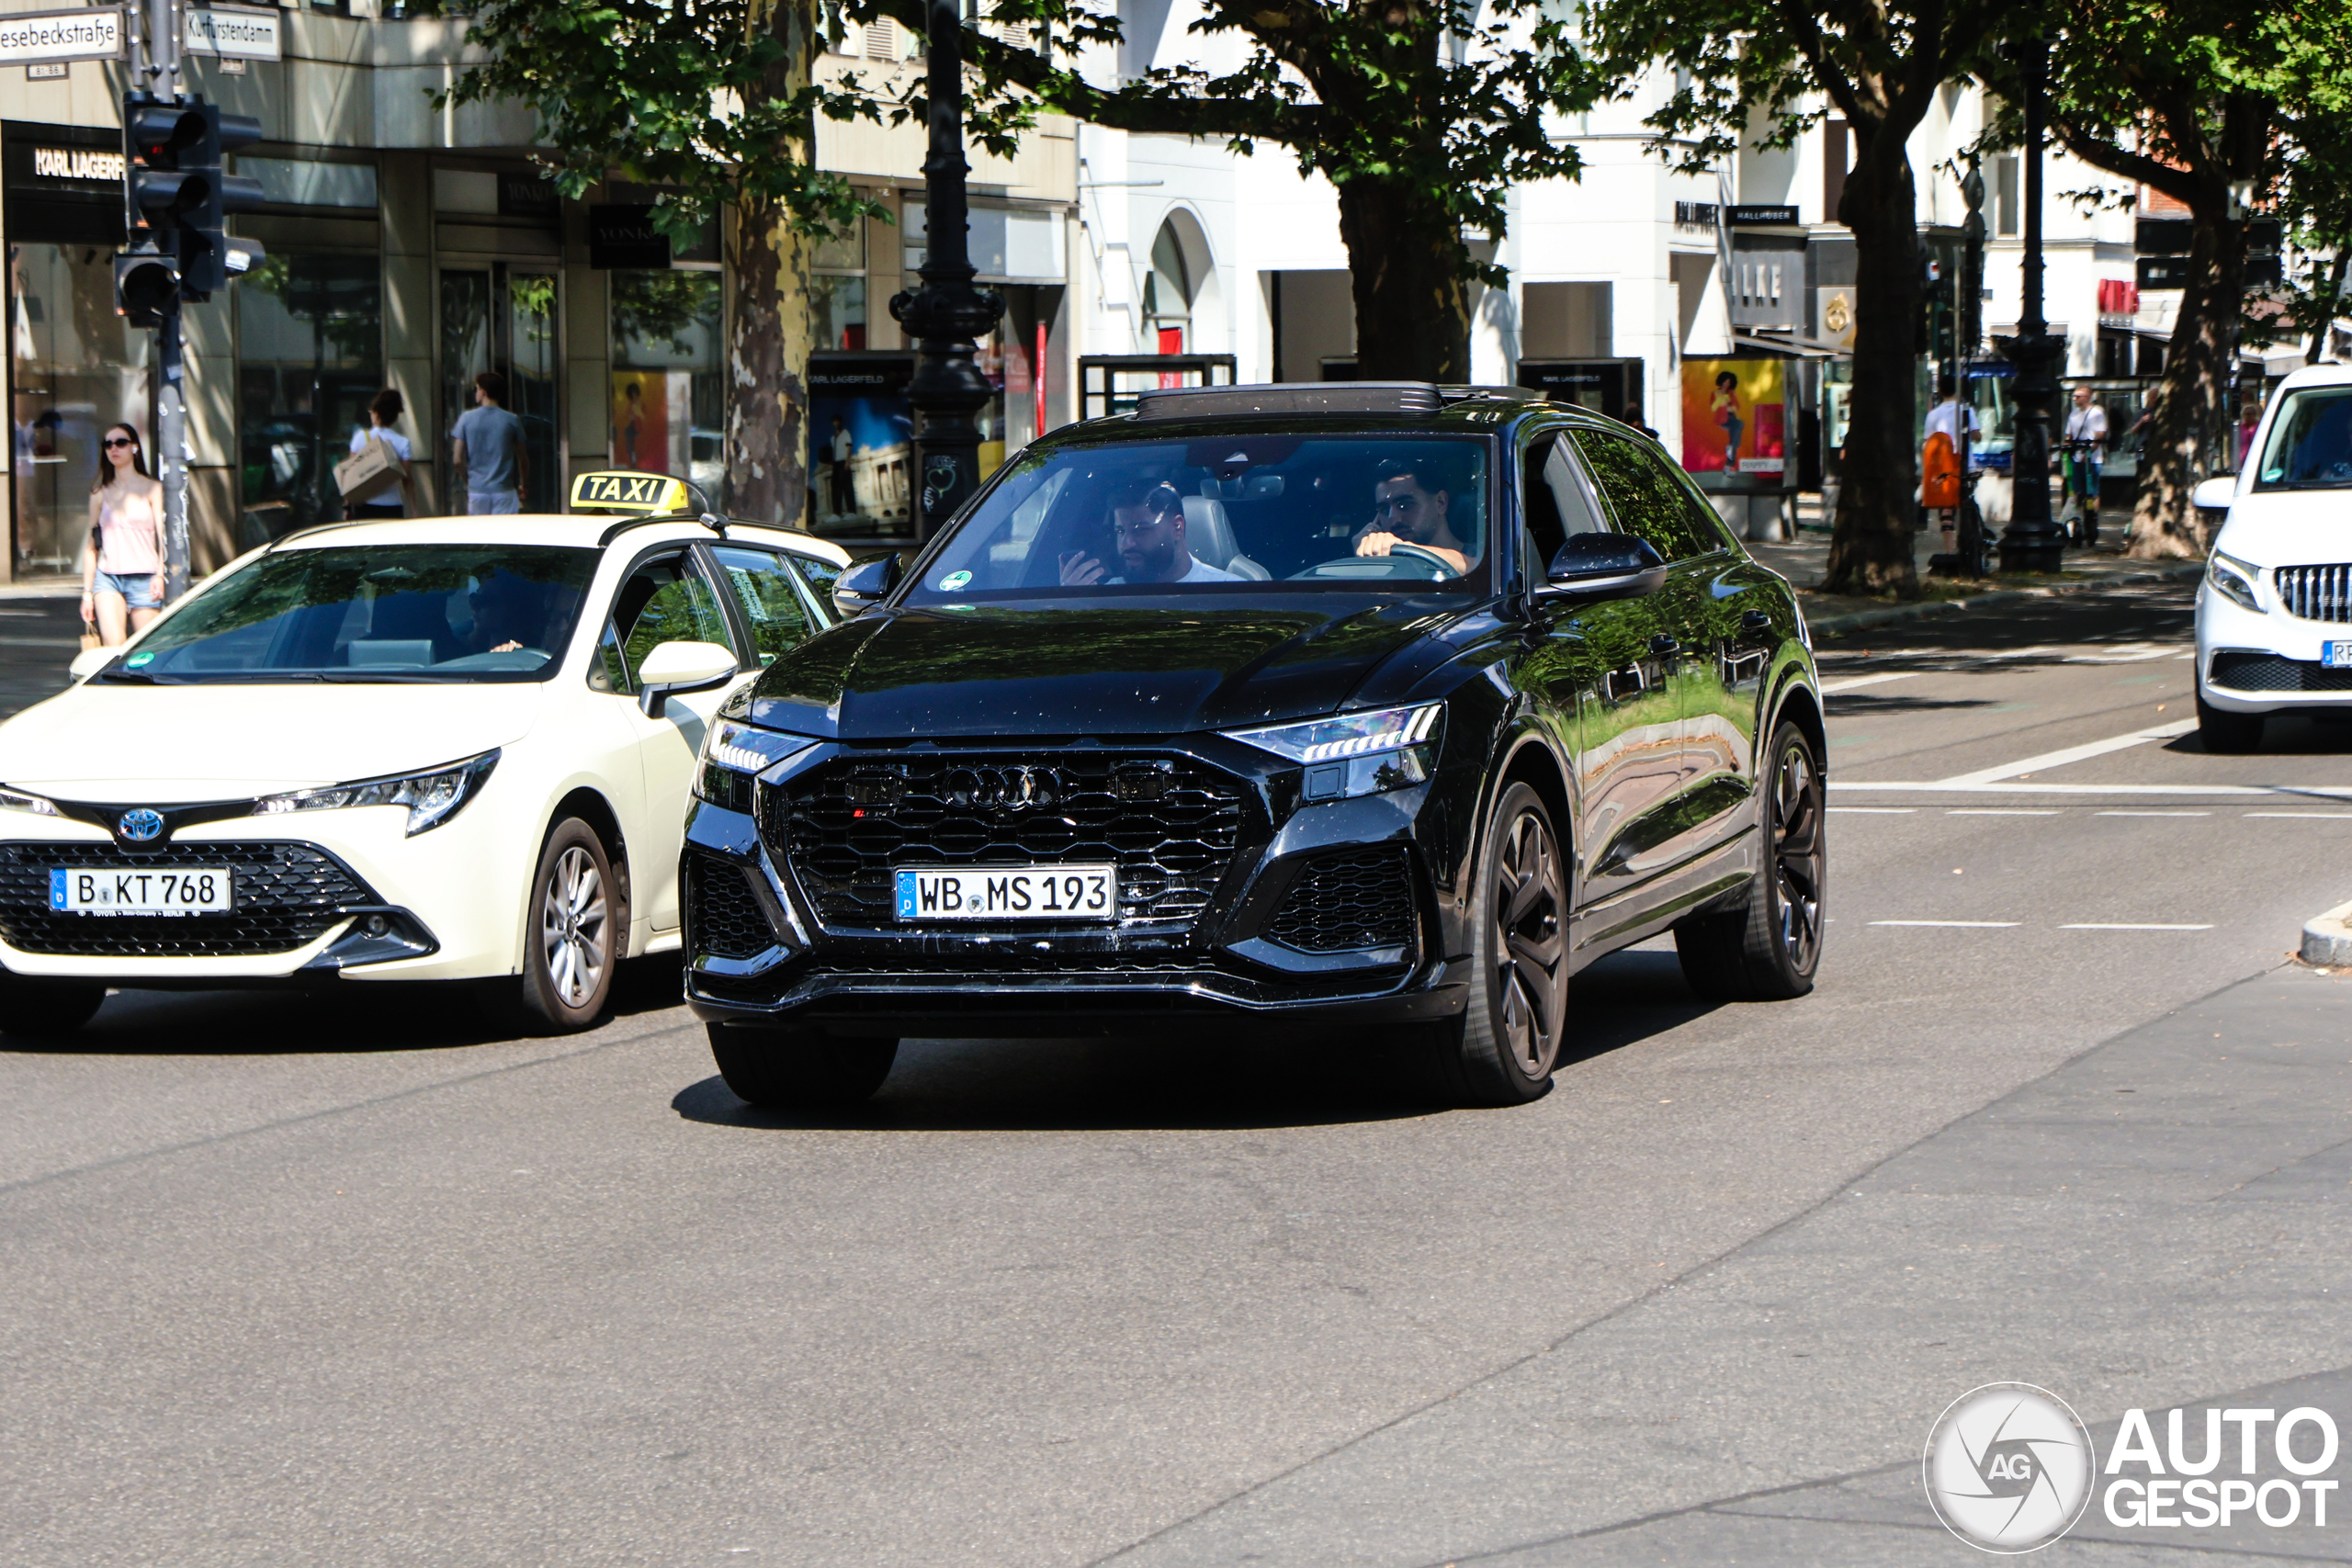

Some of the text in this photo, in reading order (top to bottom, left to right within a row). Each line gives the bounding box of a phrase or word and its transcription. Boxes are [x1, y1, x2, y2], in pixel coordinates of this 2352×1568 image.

[1, 18, 115, 47] esebeckstraße
[188, 14, 273, 43] Kurfürstendamm
[35, 148, 126, 180] KARL LAGERF
[1736, 210, 1791, 220] HALLHUBER
[831, 375, 885, 384] LAGERFELD
[589, 477, 660, 502] TAXI
[79, 874, 215, 904] B KT 768
[919, 875, 1107, 911] WB MS 193
[92, 909, 117, 918] TOYOTA
[163, 909, 187, 918] BERLIN
[903, 899, 912, 910] D
